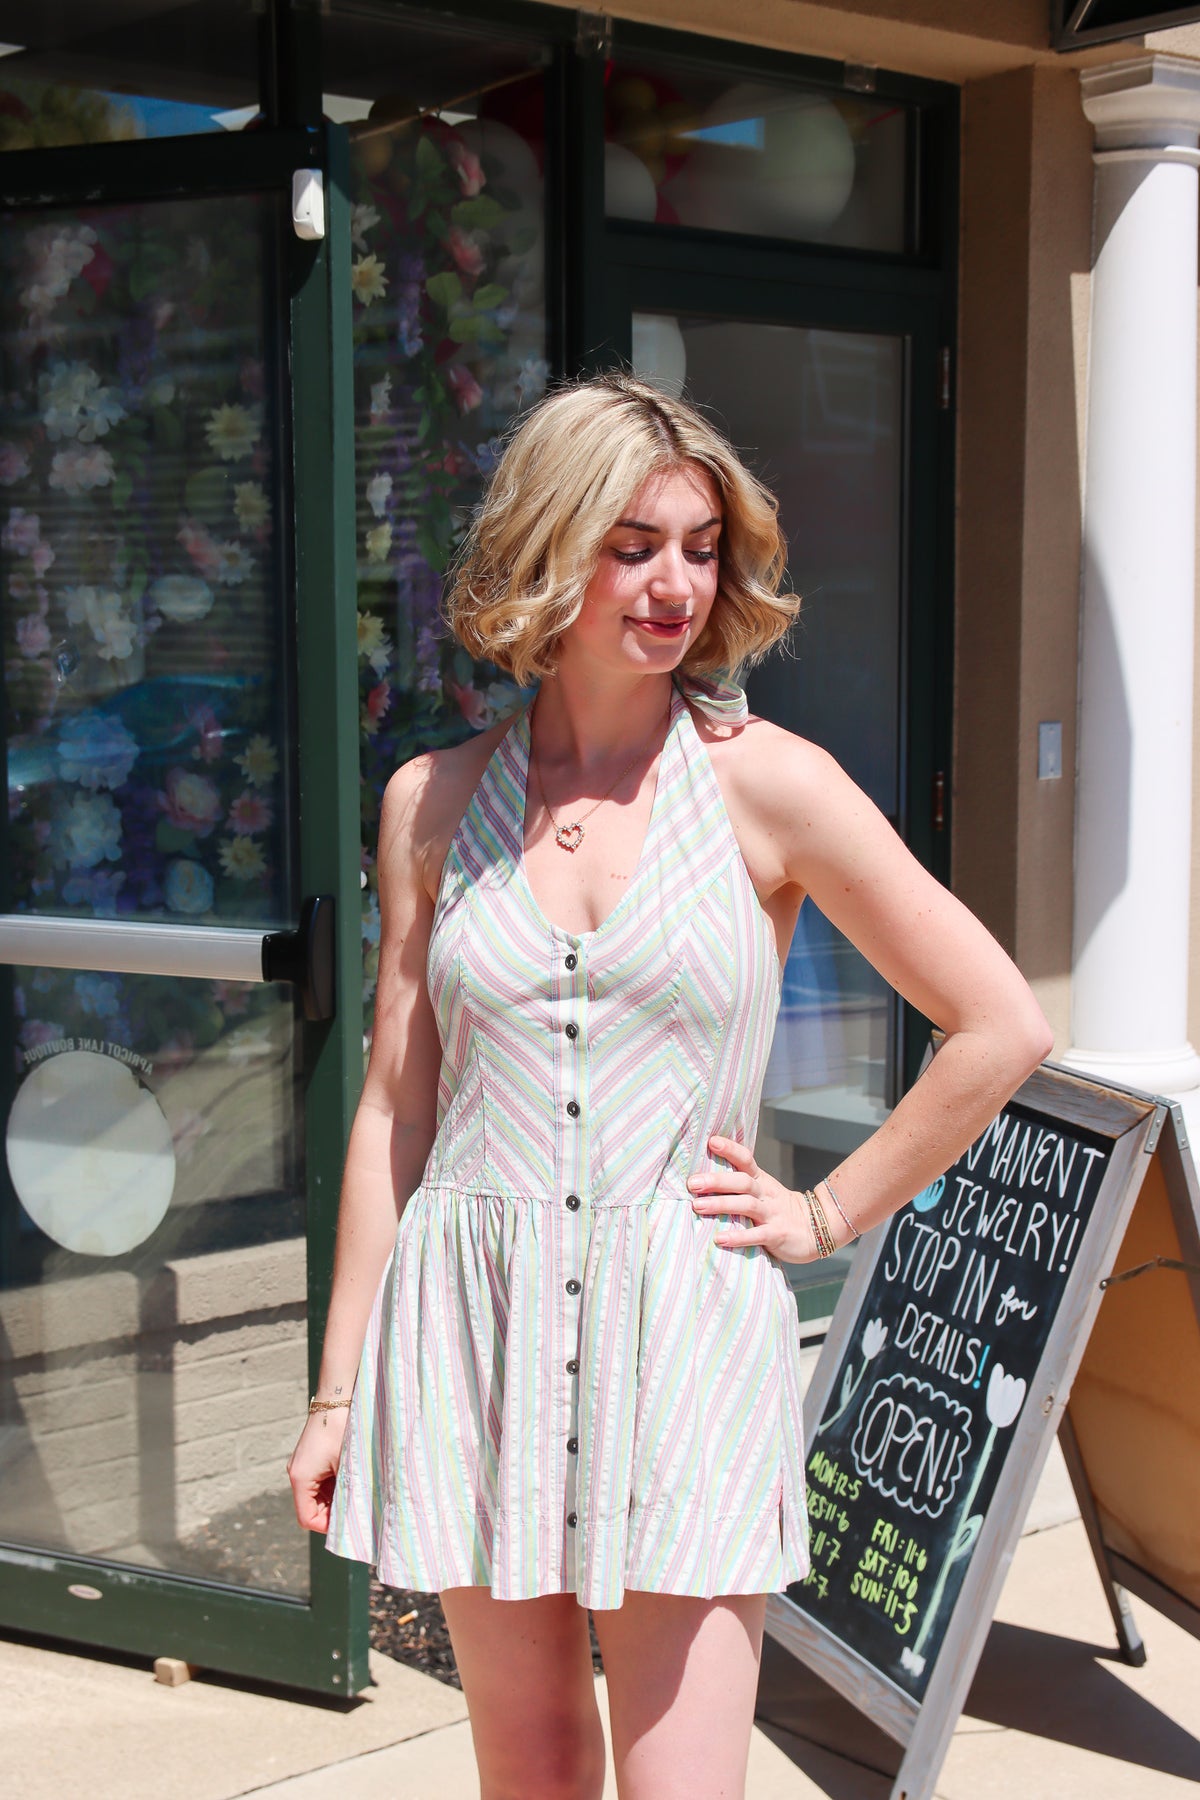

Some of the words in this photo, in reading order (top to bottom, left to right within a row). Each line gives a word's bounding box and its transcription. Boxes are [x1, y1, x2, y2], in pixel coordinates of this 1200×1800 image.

[954, 1113, 1105, 1212] MANENT
[884, 1212, 962, 1298] STOP
[951, 1248, 1000, 1324] IN
[994, 1285, 1038, 1326] for
[942, 1176, 1080, 1273] JEWELRY!
[894, 1302, 991, 1390] DETAILS!
[861, 1396, 960, 1500] OPEN!
